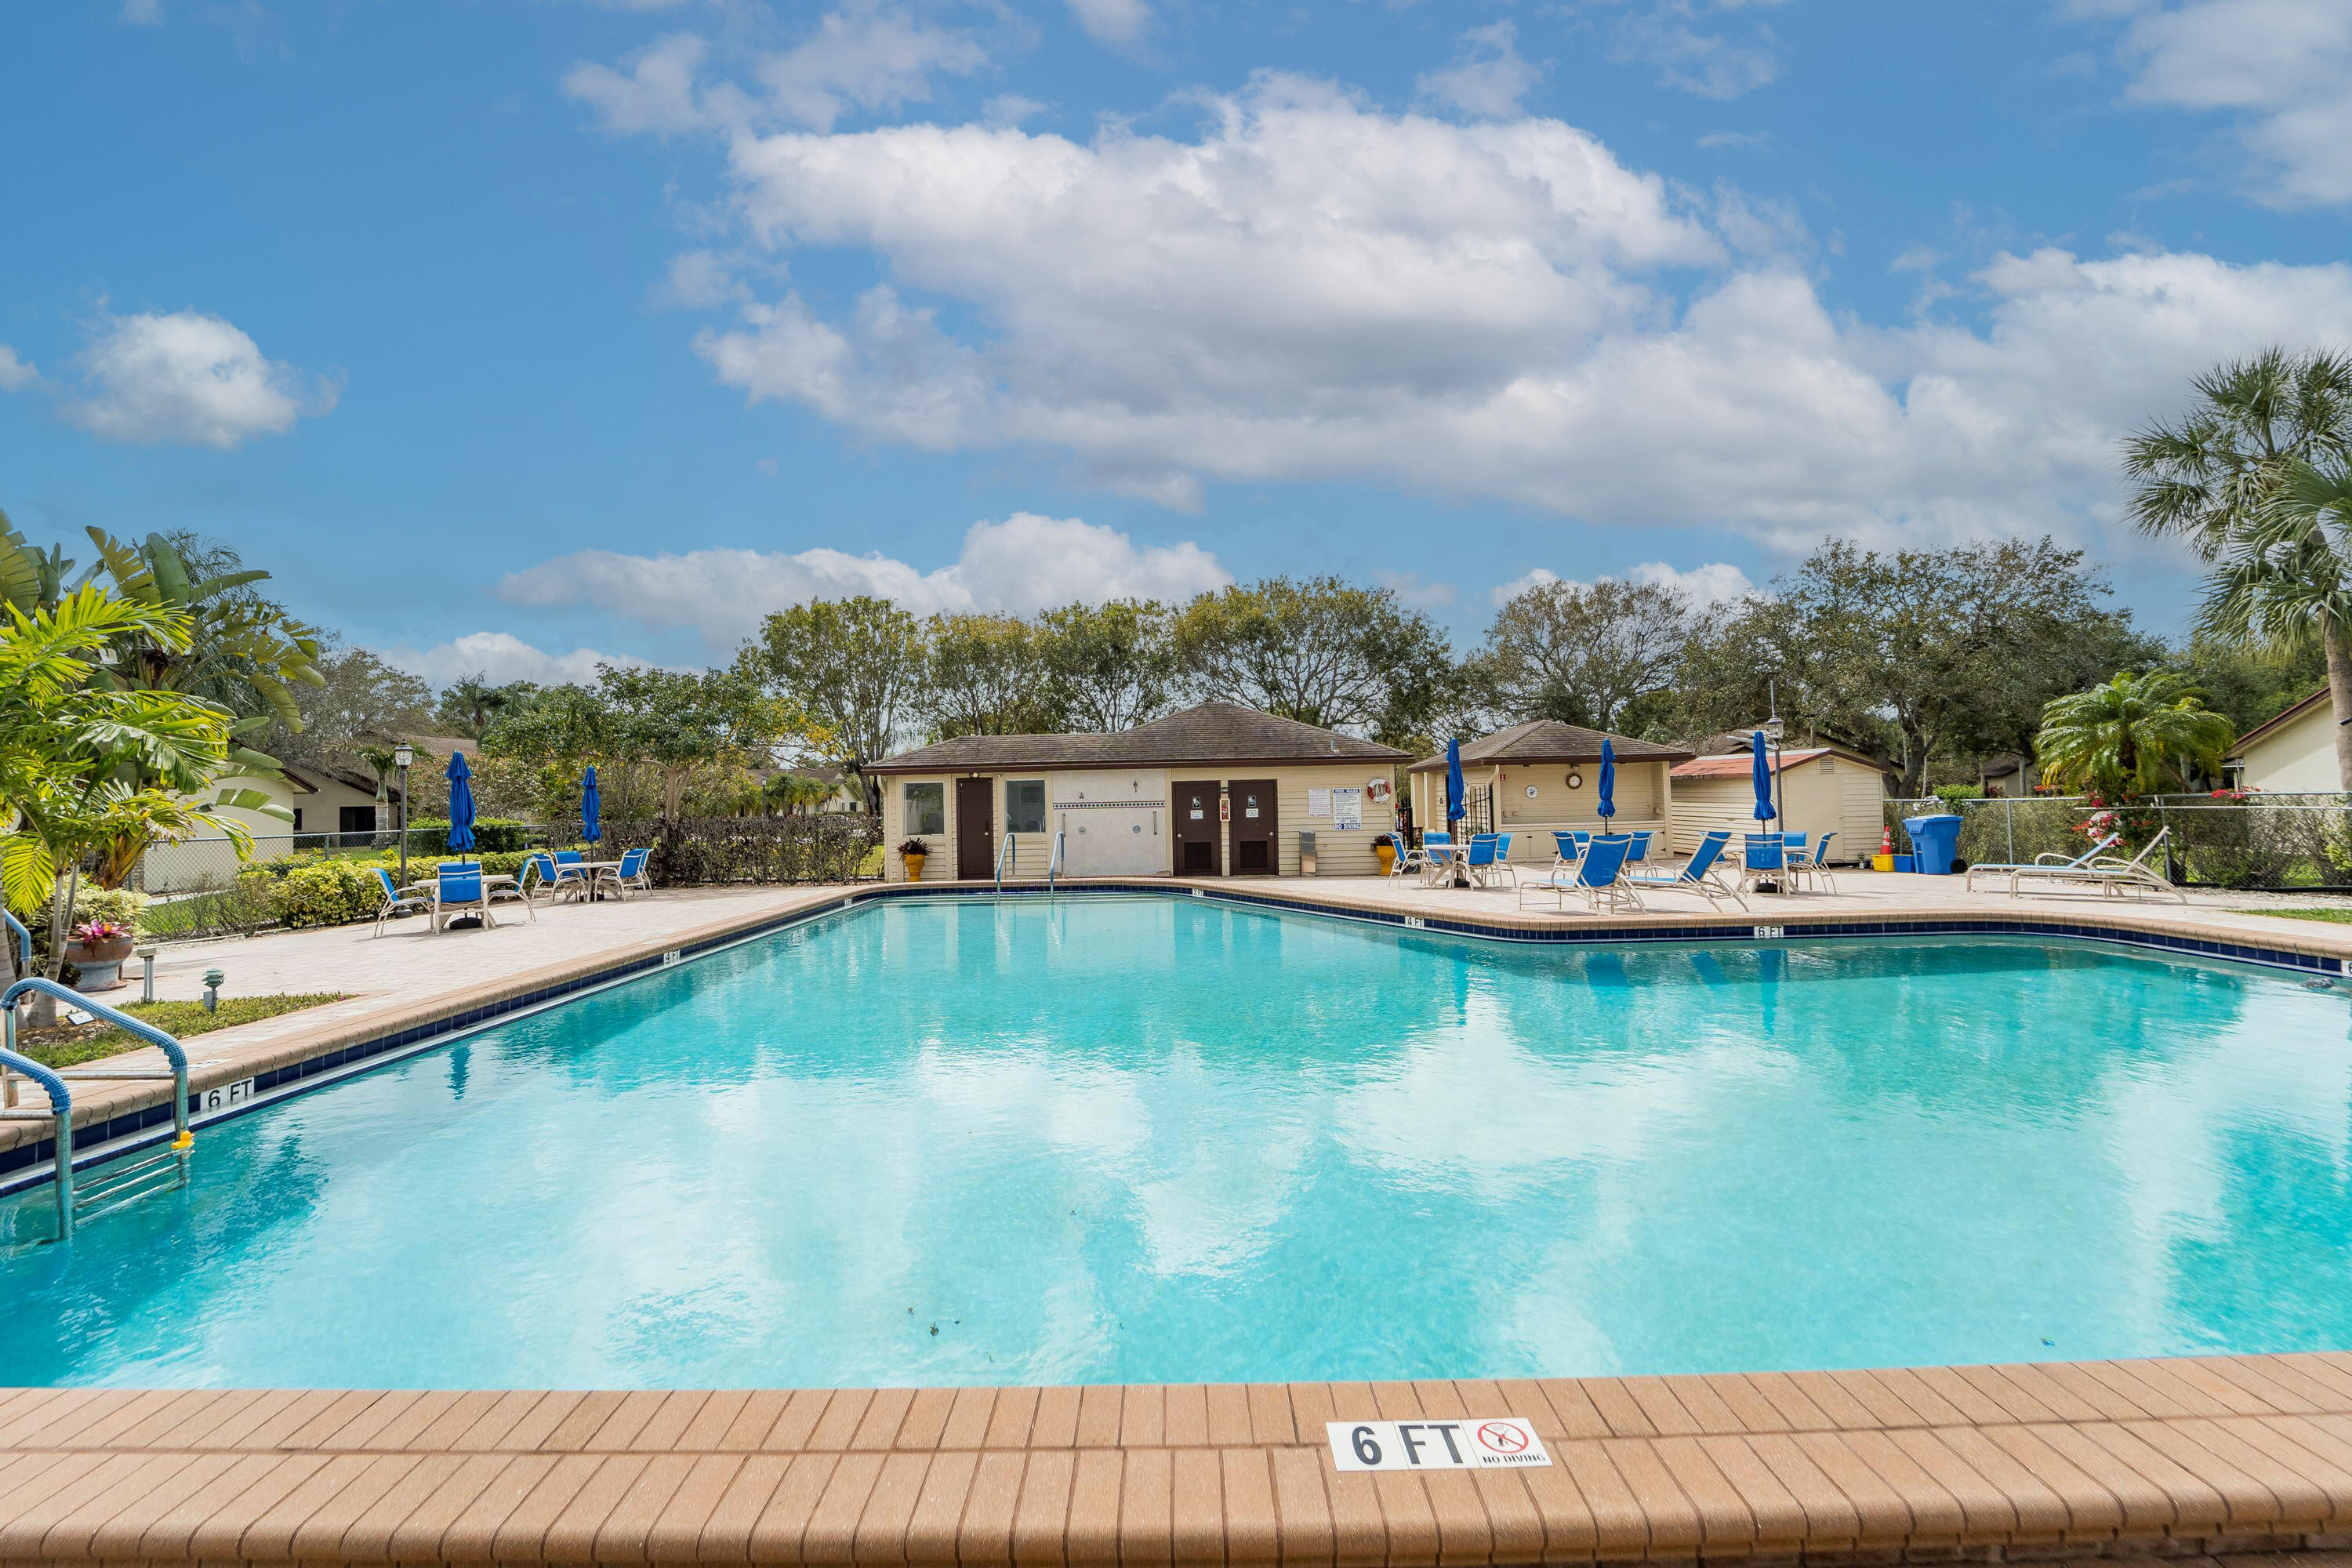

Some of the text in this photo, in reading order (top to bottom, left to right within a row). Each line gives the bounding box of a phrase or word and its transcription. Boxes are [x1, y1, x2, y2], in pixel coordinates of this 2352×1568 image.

[1414, 917, 1423, 927] FT
[1758, 926, 1782, 937] 6 FT
[209, 1079, 252, 1107] 6 FT
[1351, 1424, 1464, 1465] 6 FT
[1482, 1453, 1546, 1464] NO DIVING
